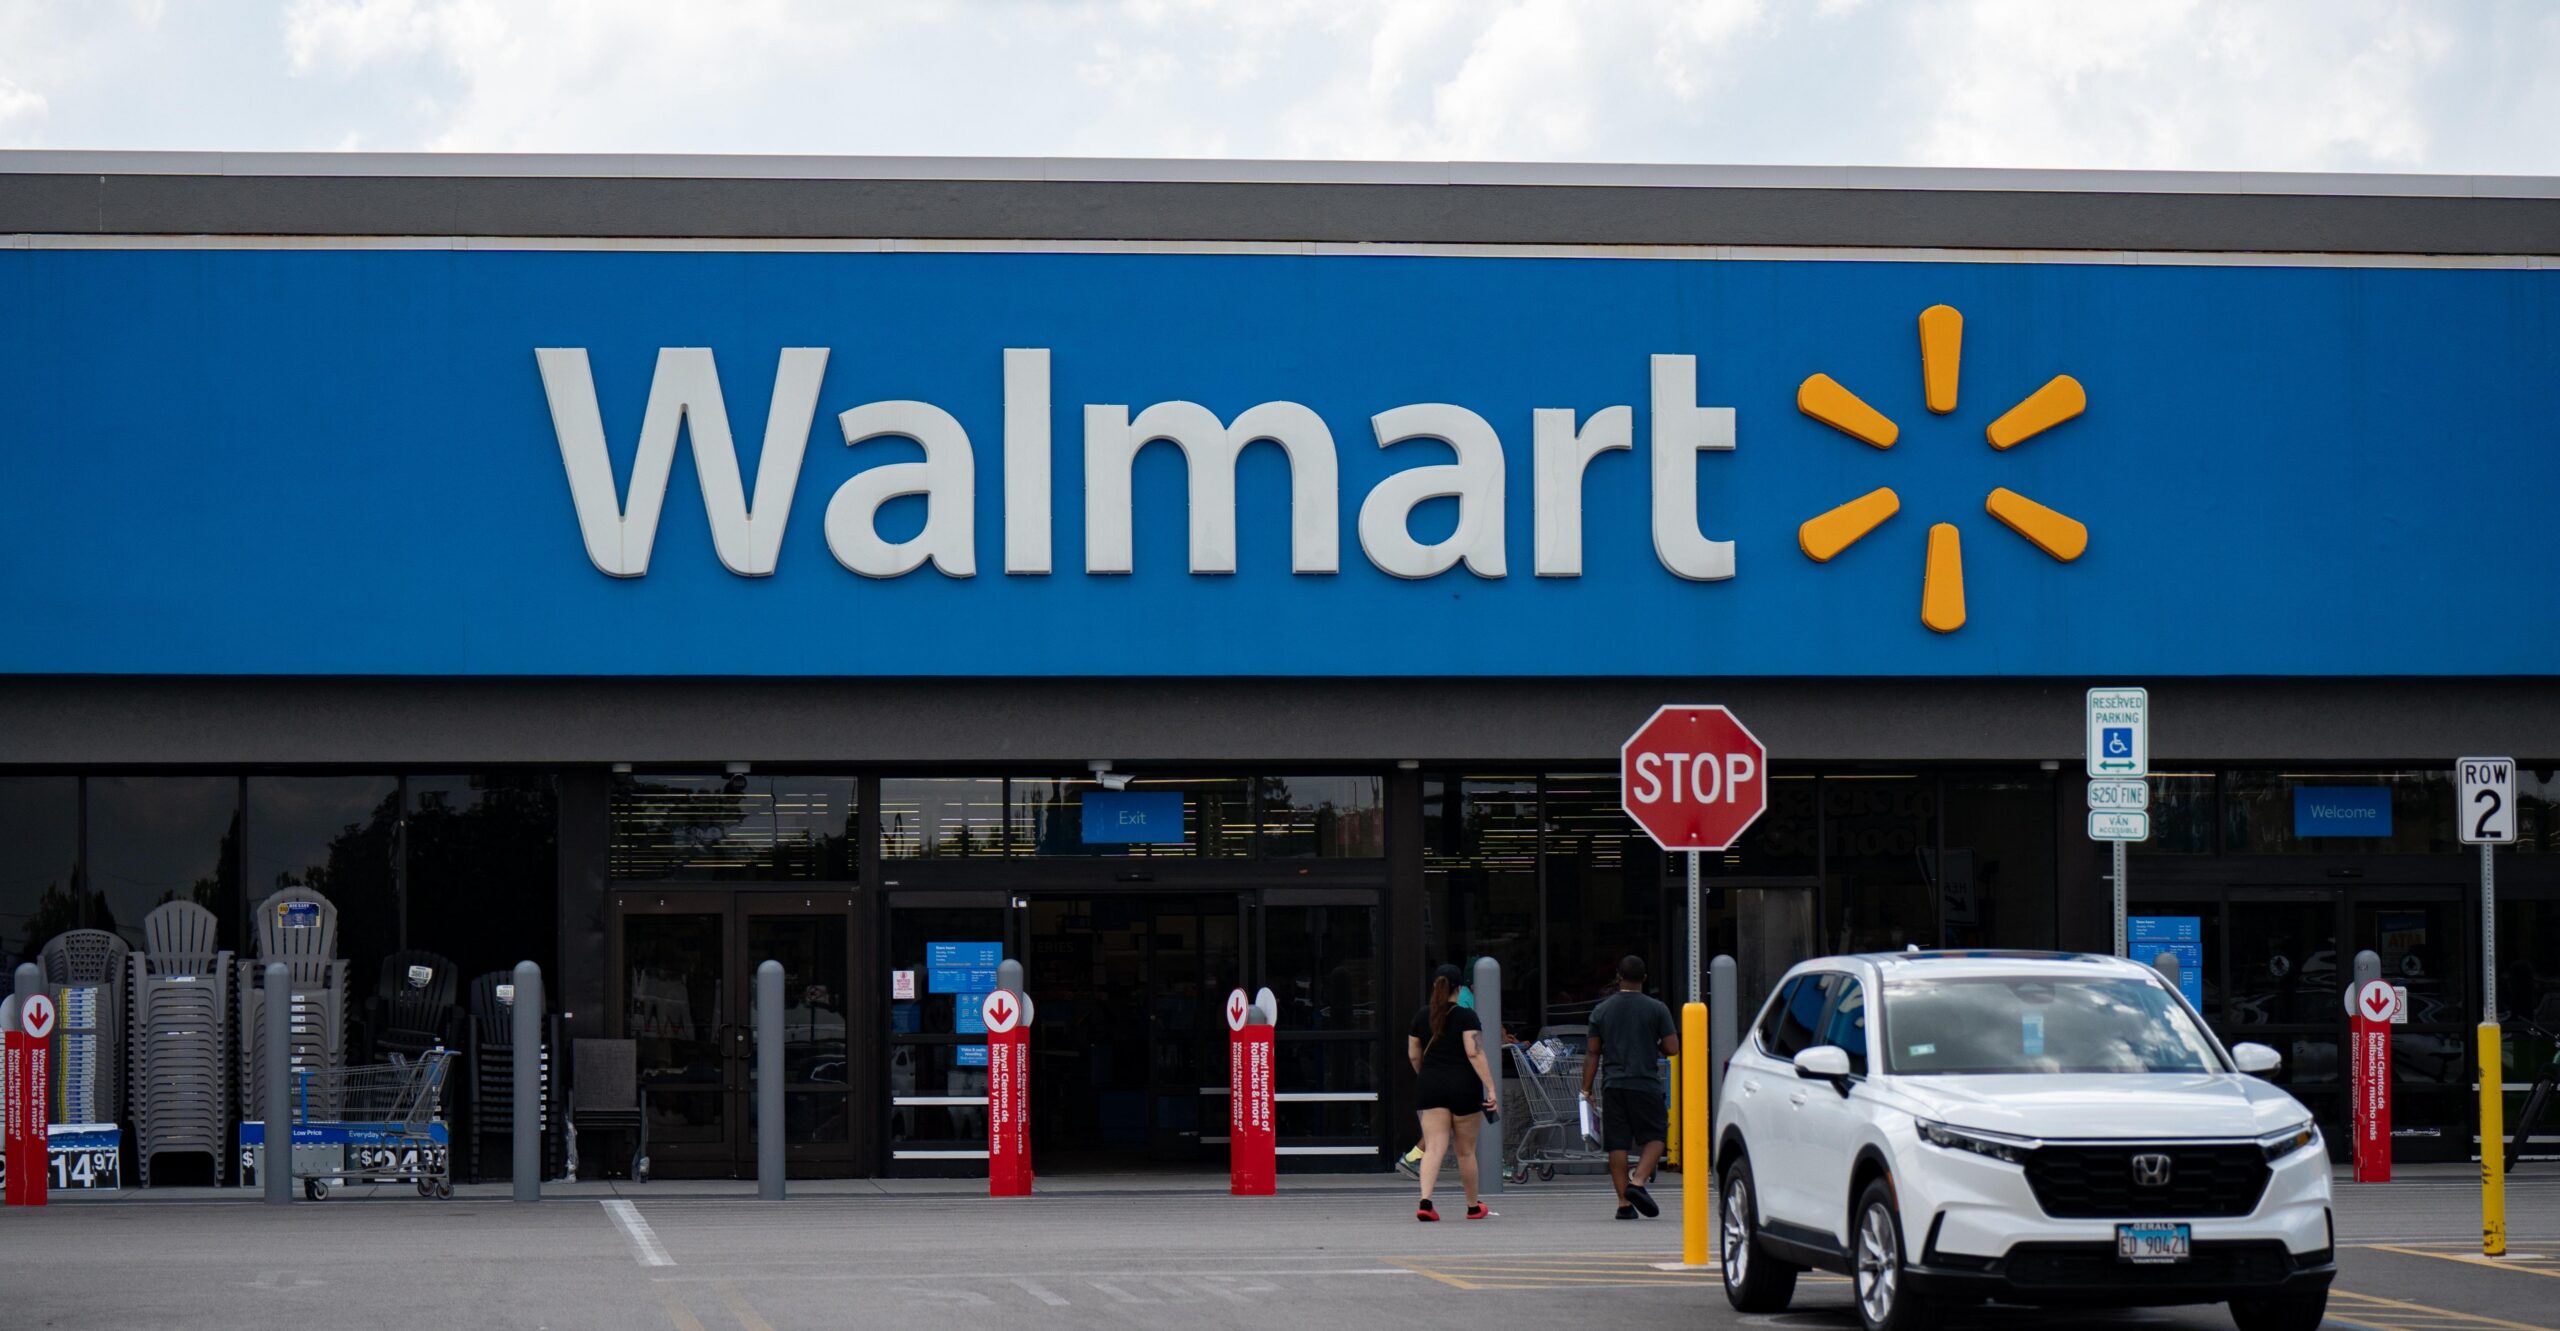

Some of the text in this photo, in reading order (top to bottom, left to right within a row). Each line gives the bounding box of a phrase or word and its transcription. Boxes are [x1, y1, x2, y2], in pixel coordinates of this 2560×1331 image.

[534, 346, 1736, 580] Walmart
[2092, 697, 2142, 709] RESERVED
[2095, 712, 2140, 724] PARKING
[1633, 752, 1755, 804] STOP
[2465, 764, 2507, 784] ROW
[2092, 787, 2143, 803] $250 FINE
[1119, 810, 1147, 825] Exit
[2109, 817, 2129, 826] VAN
[2310, 804, 2376, 819] Welcome
[2474, 789, 2502, 838] 2
[2368, 1032, 2376, 1077] Rollbacks
[992, 1043, 1000, 1089] Rollbacks
[1251, 1042, 1260, 1090] Rollbacks
[1001, 1073, 1009, 1111] Cientos
[1260, 1042, 1270, 1132] Wow! Hundreds of
[1251, 1099, 1260, 1126] more
[2377, 1098, 2385, 1109] de
[993, 1099, 1001, 1133] mucho
[1002, 1112, 1009, 1123] de
[348, 1130, 379, 1139] Everyday
[242, 1151, 254, 1168] $
[2120, 1235, 2188, 1255] ED 90421
